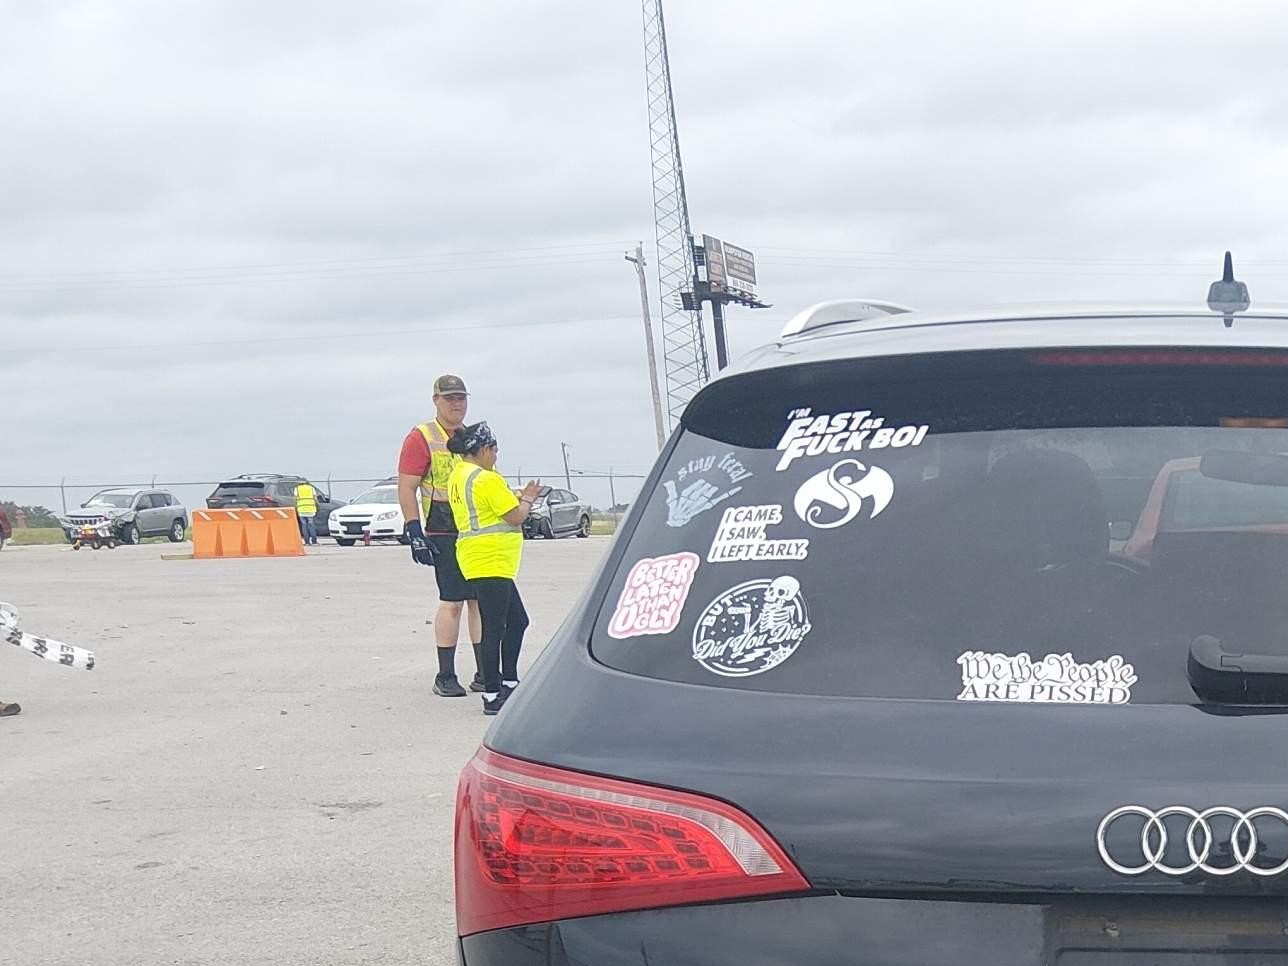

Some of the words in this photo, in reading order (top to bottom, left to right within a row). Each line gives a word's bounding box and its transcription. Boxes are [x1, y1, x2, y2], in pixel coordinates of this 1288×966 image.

[787, 407, 812, 420] I'M
[776, 410, 871, 450] FAST
[862, 417, 884, 430] AS
[776, 430, 872, 471] FUCK
[869, 425, 928, 449] BOI
[677, 453, 717, 480] stay
[717, 451, 753, 484] feral
[734, 508, 780, 523] CAME.
[728, 526, 764, 540] SAW.
[720, 544, 755, 559] LEFT
[755, 543, 804, 558] EARLY.
[632, 559, 692, 587] BETTER
[615, 601, 679, 631] UGLY
[692, 637, 733, 660] Did
[729, 631, 768, 658] You
[767, 623, 811, 644] Die?
[963, 653, 1008, 681] We
[1041, 655, 1135, 688] People
[961, 683, 1020, 700] ARE
[1030, 685, 1128, 703] PISSED
